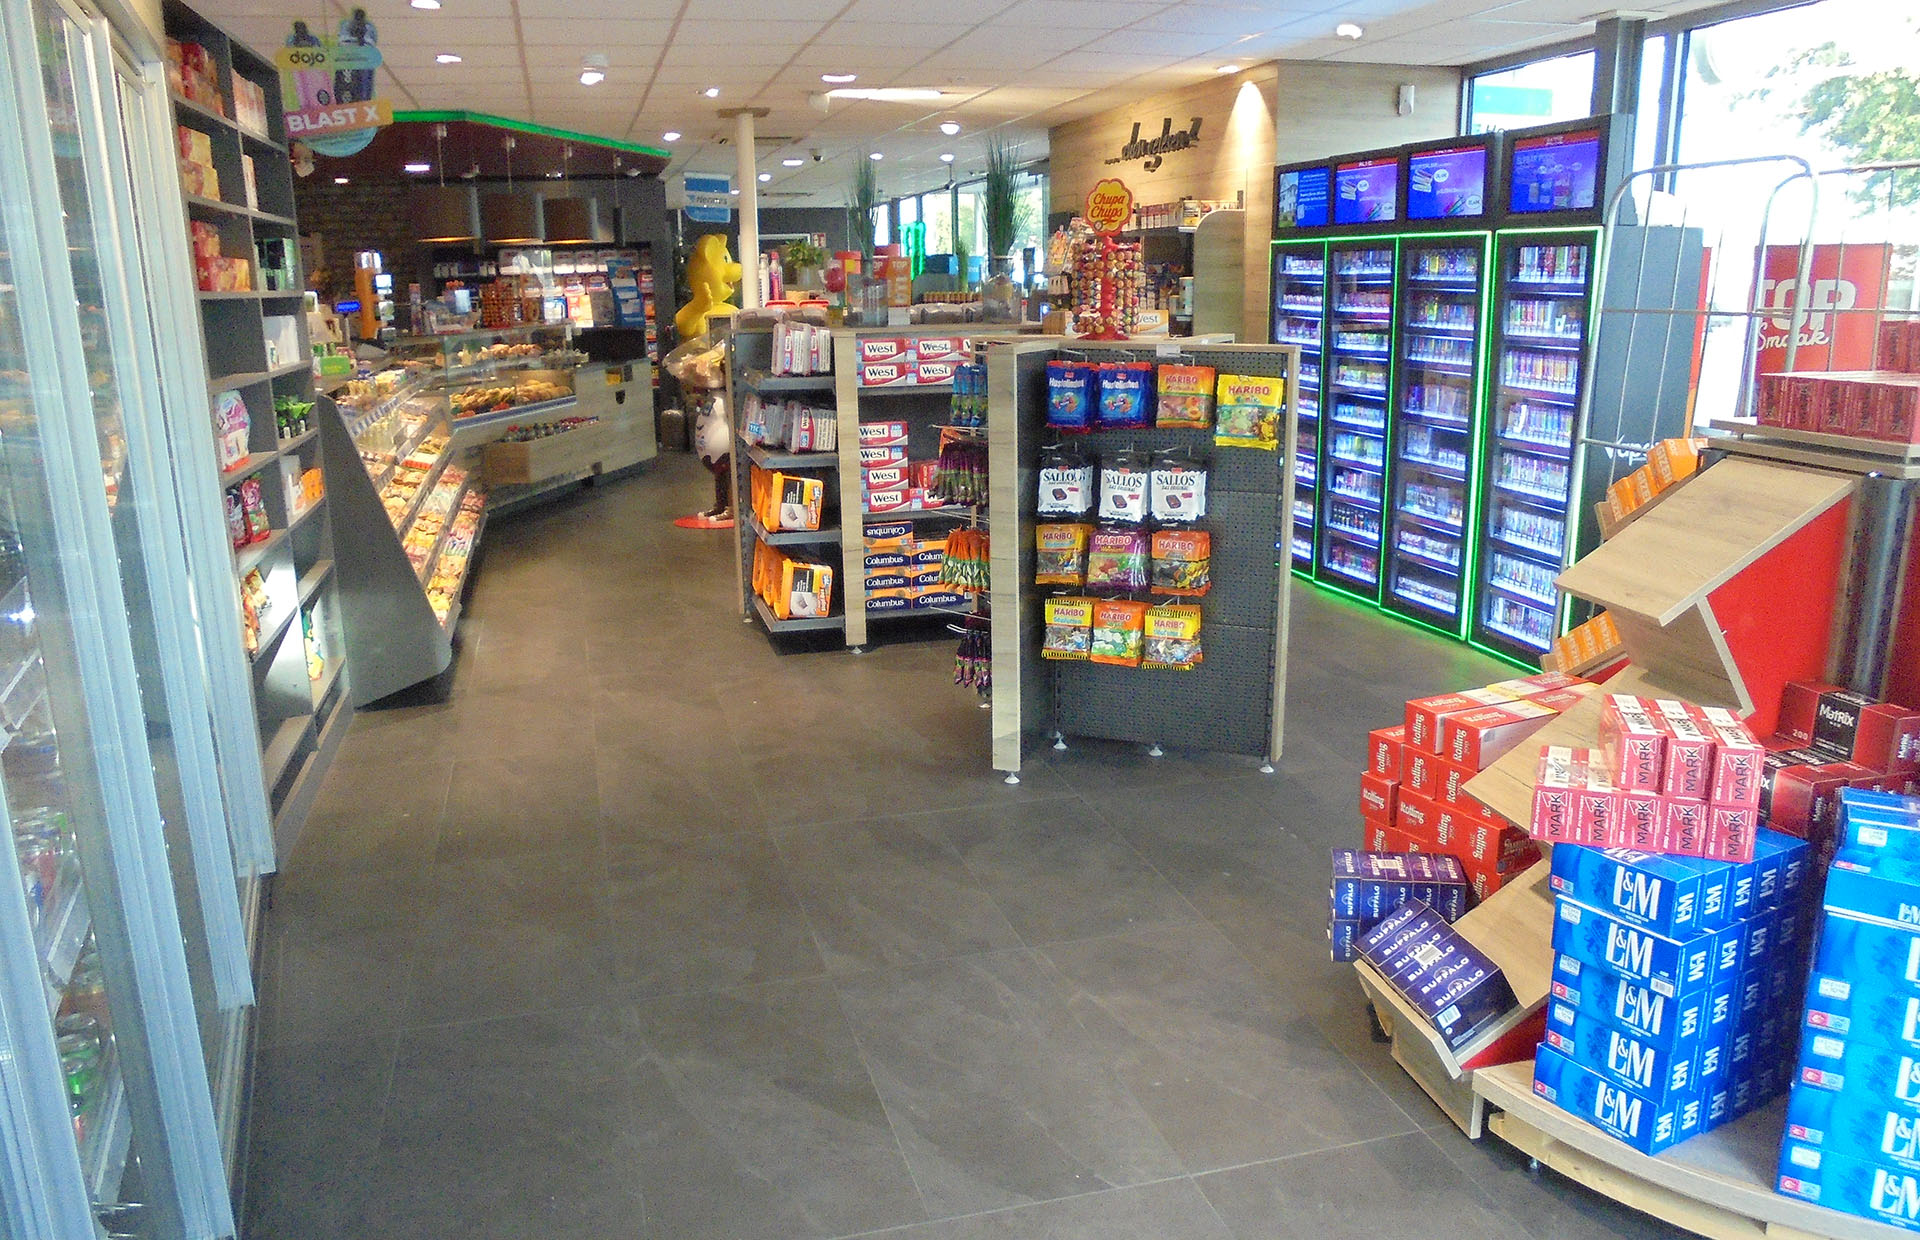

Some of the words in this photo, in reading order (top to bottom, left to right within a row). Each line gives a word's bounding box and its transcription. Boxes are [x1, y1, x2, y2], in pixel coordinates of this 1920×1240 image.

[289, 50, 326, 66] dojo
[286, 107, 356, 132] BLAST
[363, 105, 378, 122] X
[1090, 206, 1123, 219] Chups
[1093, 193, 1126, 206] Chupa
[867, 344, 894, 353] West
[922, 342, 949, 351] West
[868, 368, 895, 377] West
[922, 366, 948, 375] West
[1166, 375, 1198, 385] HARIBO
[1228, 385, 1270, 395] HARIBO
[860, 427, 886, 436] West
[861, 450, 887, 458] West
[871, 471, 898, 479] West
[1105, 474, 1142, 487] SALLOS
[1156, 474, 1195, 486] SALLOS
[873, 494, 899, 503] West
[867, 526, 906, 536] Columbus
[1042, 532, 1073, 540] HARIBO
[1095, 535, 1132, 545] HARIBO
[1158, 540, 1194, 551] HARIBO
[865, 556, 904, 565] Columbus
[918, 552, 944, 561] Colum
[866, 578, 904, 587] Columbus
[866, 600, 905, 609] Columbus
[919, 595, 957, 604] Columbus
[1053, 607, 1085, 617] HARIBO
[1100, 612, 1132, 622] HARIBO
[1153, 619, 1186, 629] HARIBO
[1412, 713, 1425, 745] Rolling
[1792, 728, 1809, 741] 200
[1376, 742, 1389, 774] Rolling
[1453, 728, 1467, 762] Rolling
[1411, 757, 1424, 789] Rolling
[1446, 770, 1461, 803] Rolling
[1363, 788, 1386, 810] Rolling
[1400, 801, 1425, 825] Rolling
[1437, 813, 1452, 846] Rolling
[1473, 826, 1488, 860] Rolling
[1613, 865, 1662, 921] L&M
[1734, 877, 1753, 907] L&M
[1760, 868, 1777, 898] L&M
[1347, 882, 1355, 916] BUFFALO
[1373, 885, 1381, 918] BUFFALO
[1451, 889, 1459, 921] BUFFALO
[1675, 892, 1695, 924] L&M
[1704, 884, 1723, 915] L&M
[1369, 908, 1413, 945] BUFFALO
[1383, 920, 1429, 956] BUFFALO
[1605, 922, 1654, 978] L&M
[1720, 939, 1738, 970] L&M
[1749, 927, 1767, 957] L&M
[1421, 957, 1470, 994] BUFFALO
[1688, 951, 1706, 982] L&M
[1435, 969, 1484, 1007] BUFFALO
[1615, 979, 1664, 1036] L&M
[1681, 1006, 1698, 1038] L&M
[1712, 993, 1729, 1024] L&M
[1607, 1030, 1655, 1088] L&M
[1702, 1046, 1720, 1077] L&M
[1671, 1060, 1689, 1091] L&M
[1895, 1056, 1920, 1101] L&
[1594, 1080, 1642, 1138] L&M
[1681, 1100, 1699, 1131] L&M
[1709, 1090, 1727, 1120] L&M
[1655, 1111, 1674, 1143] L&M
